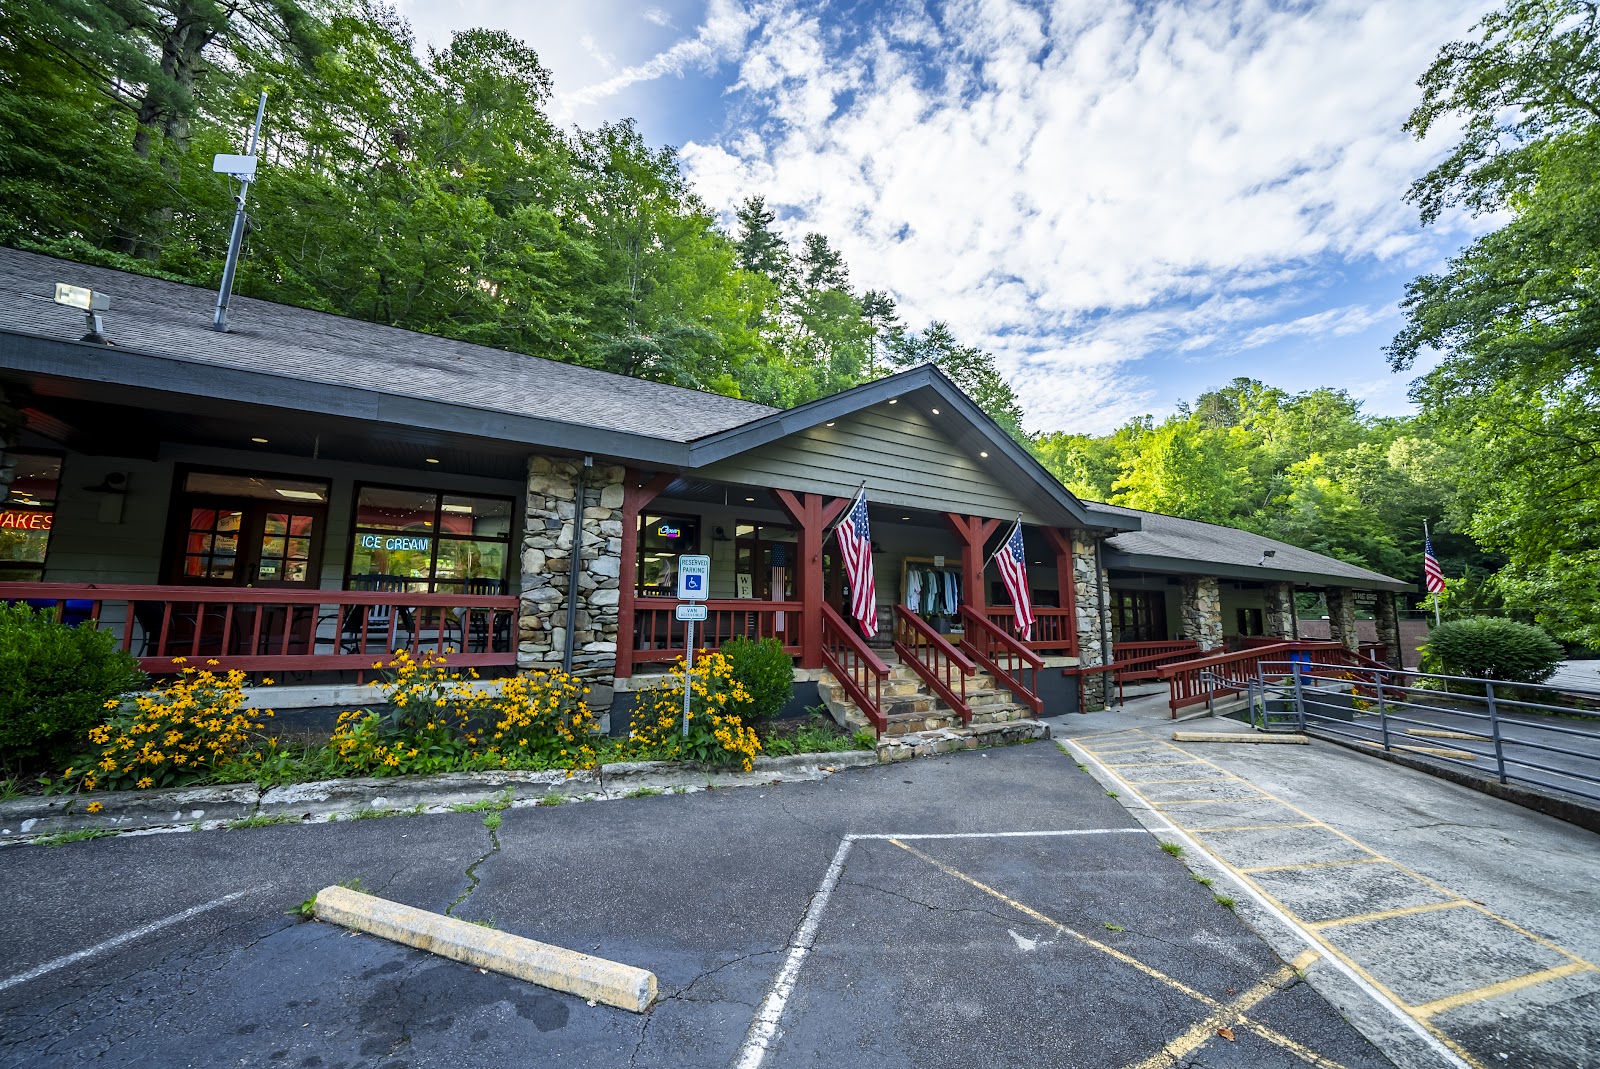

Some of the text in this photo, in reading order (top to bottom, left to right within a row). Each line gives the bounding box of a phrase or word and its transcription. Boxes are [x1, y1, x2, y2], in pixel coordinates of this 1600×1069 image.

[361, 535, 429, 551] ICE CREAM
[682, 566, 705, 574] PARKING
